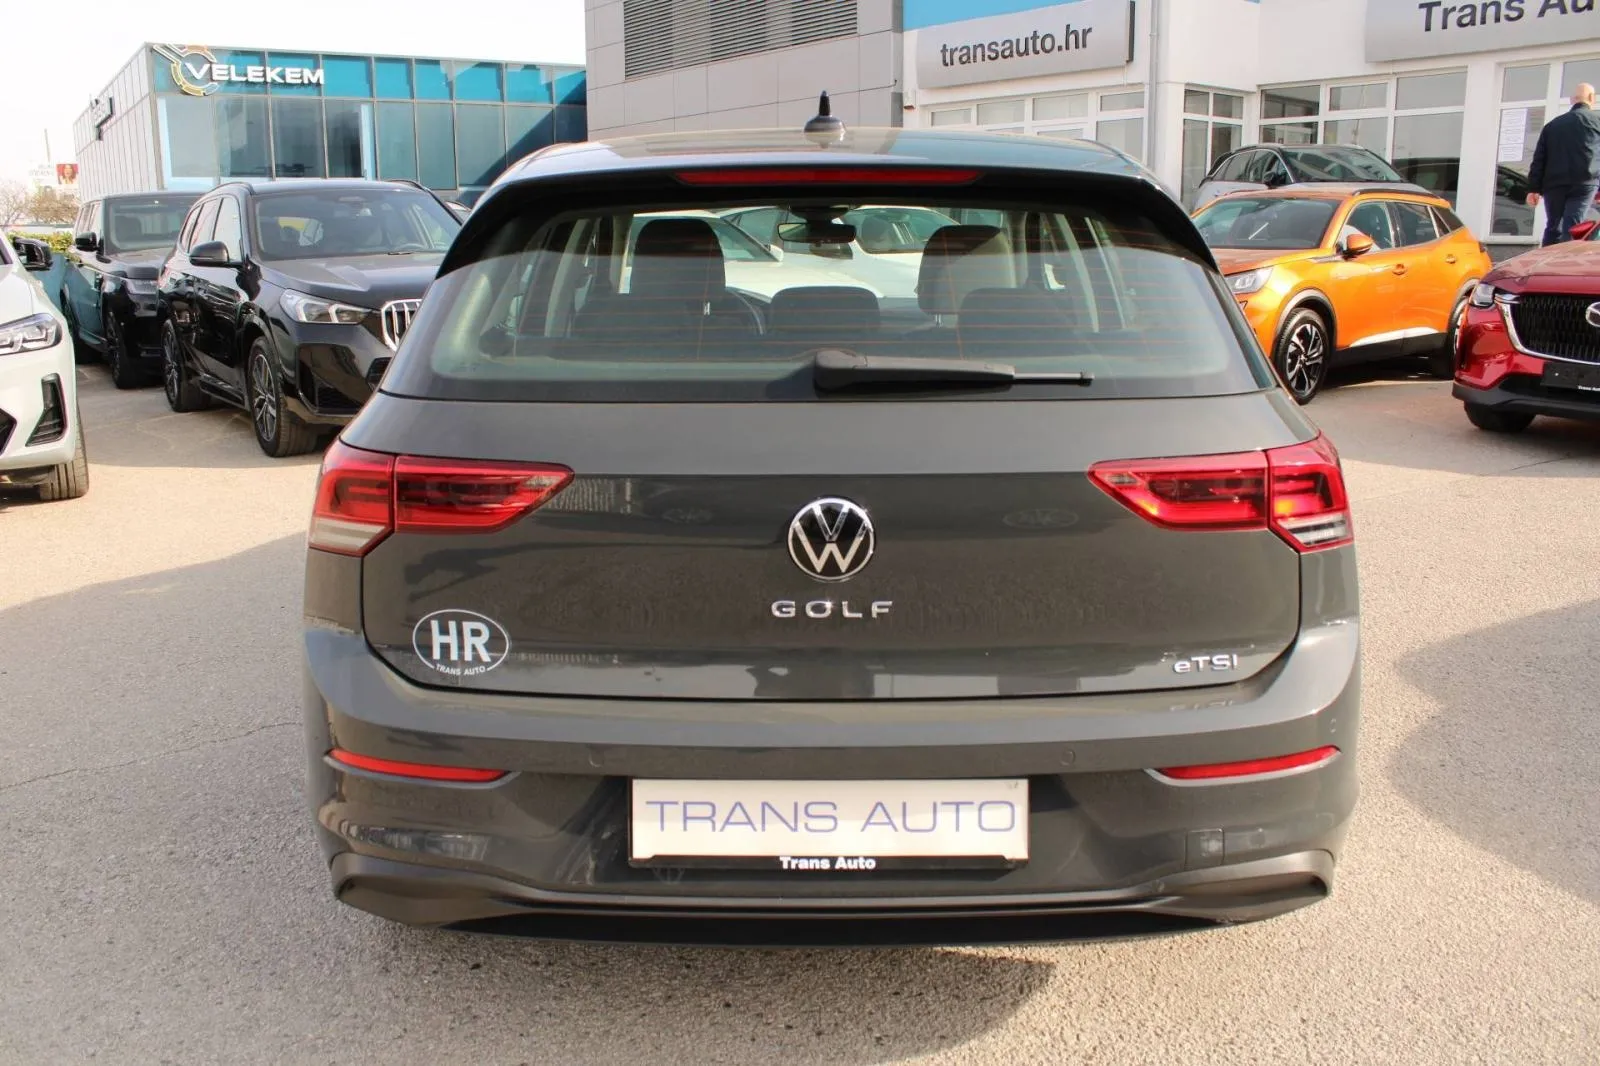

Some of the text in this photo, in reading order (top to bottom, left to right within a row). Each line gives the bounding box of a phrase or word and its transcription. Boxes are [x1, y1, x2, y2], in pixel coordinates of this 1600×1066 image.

[1418, 0, 1525, 32] Trans
[940, 23, 1093, 67] transauto.hr
[185, 62, 325, 85] VELEKEM
[771, 600, 893, 618] GOLF
[430, 619, 492, 662] HR
[436, 663, 486, 676] TRANS AUTO
[1173, 653, 1238, 673] eTSI
[645, 800, 1016, 833] TRANS AUTO
[779, 856, 877, 870] Trans Auto
